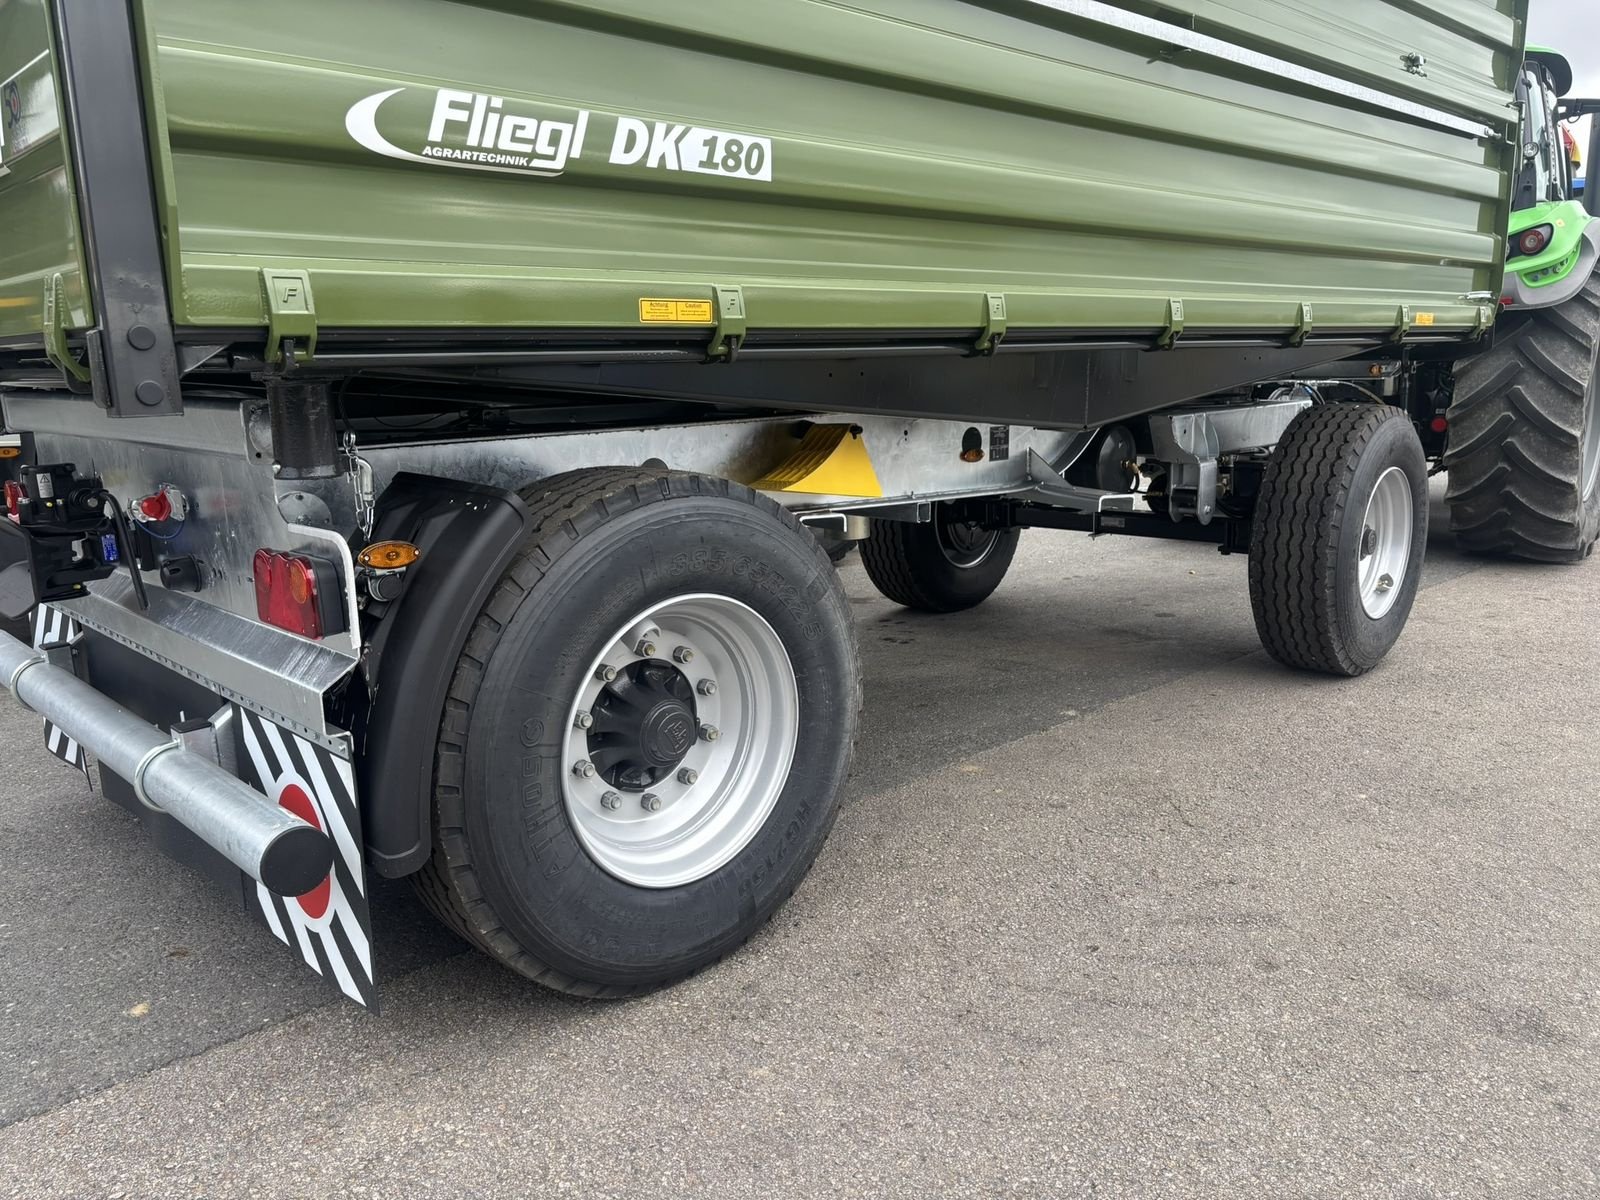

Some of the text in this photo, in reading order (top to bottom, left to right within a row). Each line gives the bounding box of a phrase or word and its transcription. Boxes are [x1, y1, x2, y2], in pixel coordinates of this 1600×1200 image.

[421, 145, 530, 167] AGRARTECHNIK
[427, 87, 765, 176] Fliegl DK 180
